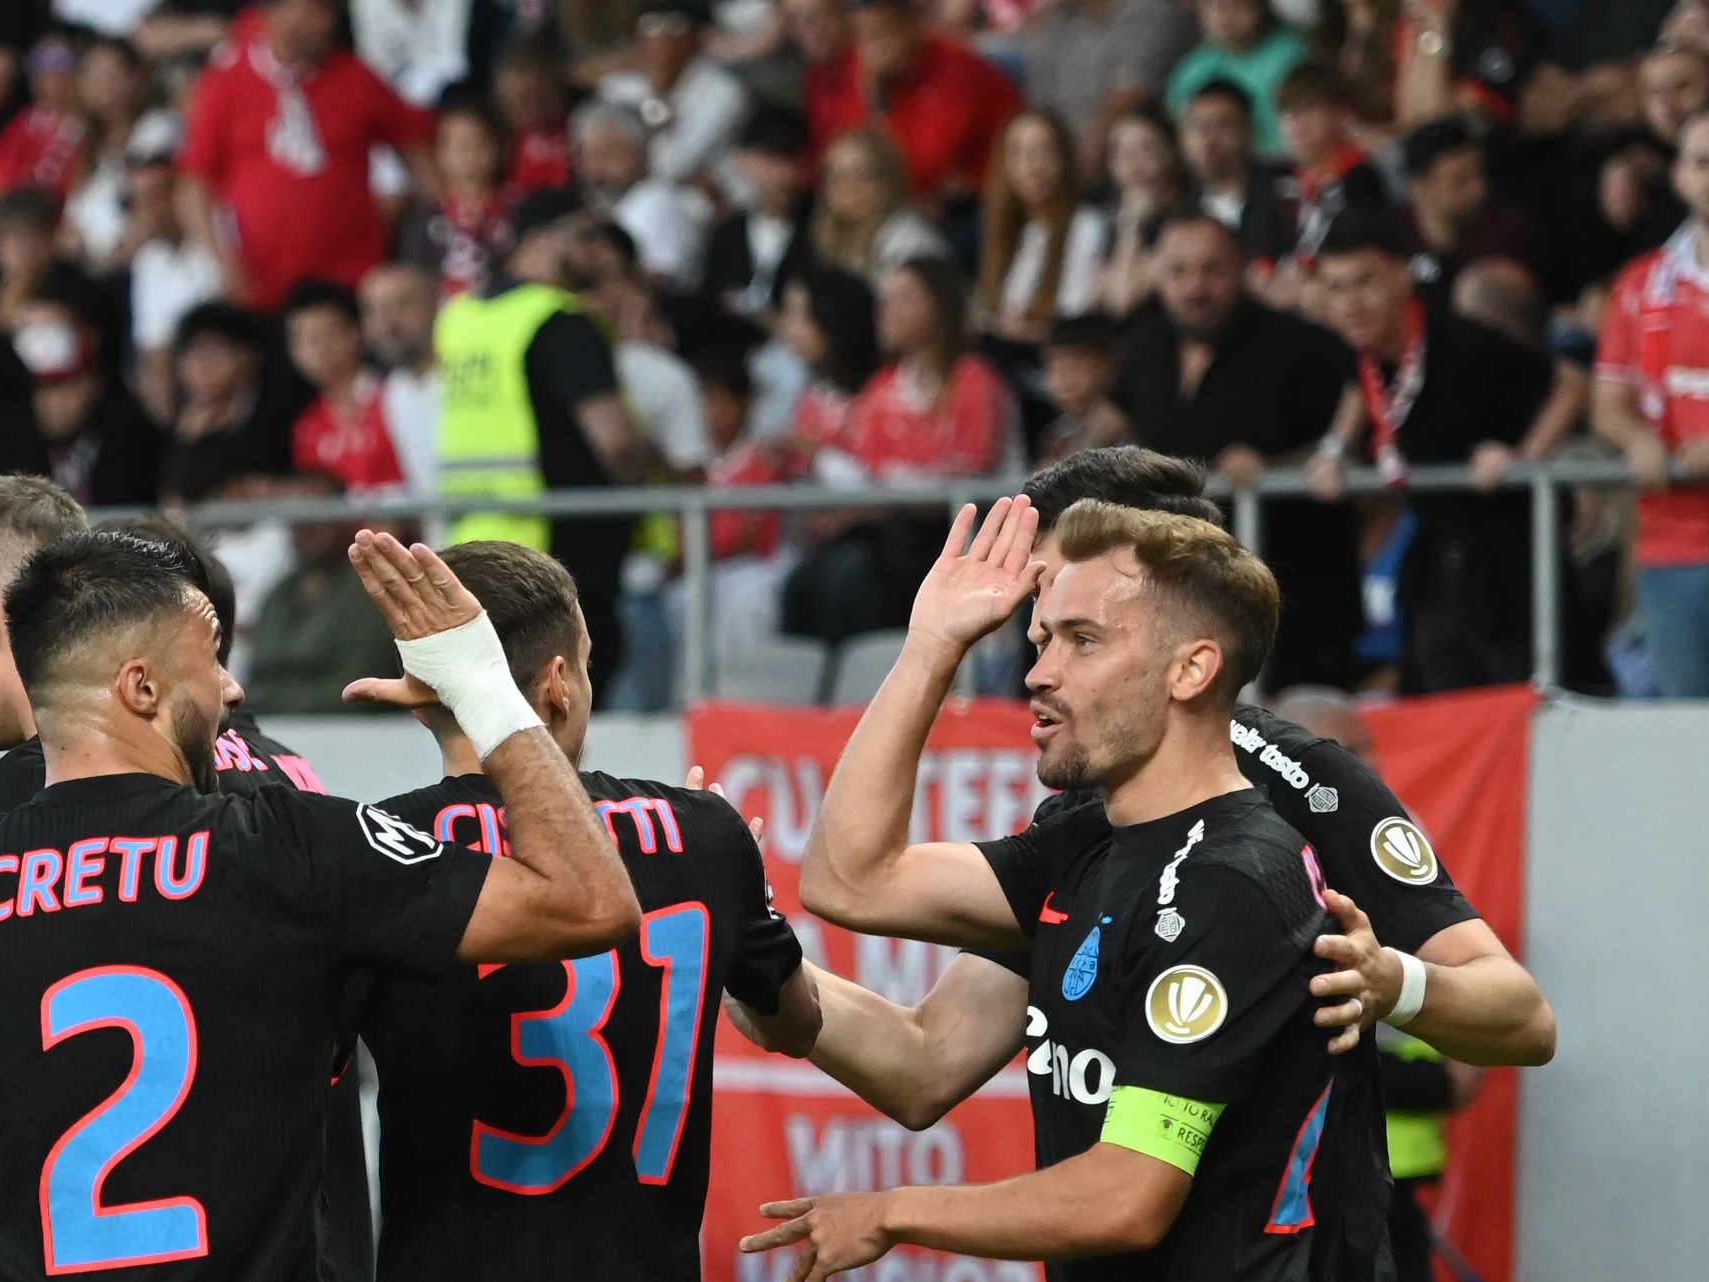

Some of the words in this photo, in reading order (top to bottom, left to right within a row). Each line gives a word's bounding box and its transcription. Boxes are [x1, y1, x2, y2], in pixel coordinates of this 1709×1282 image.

[434, 797, 683, 857] CITTI
[39, 964, 209, 1276] 2
[471, 901, 709, 1195] 31
